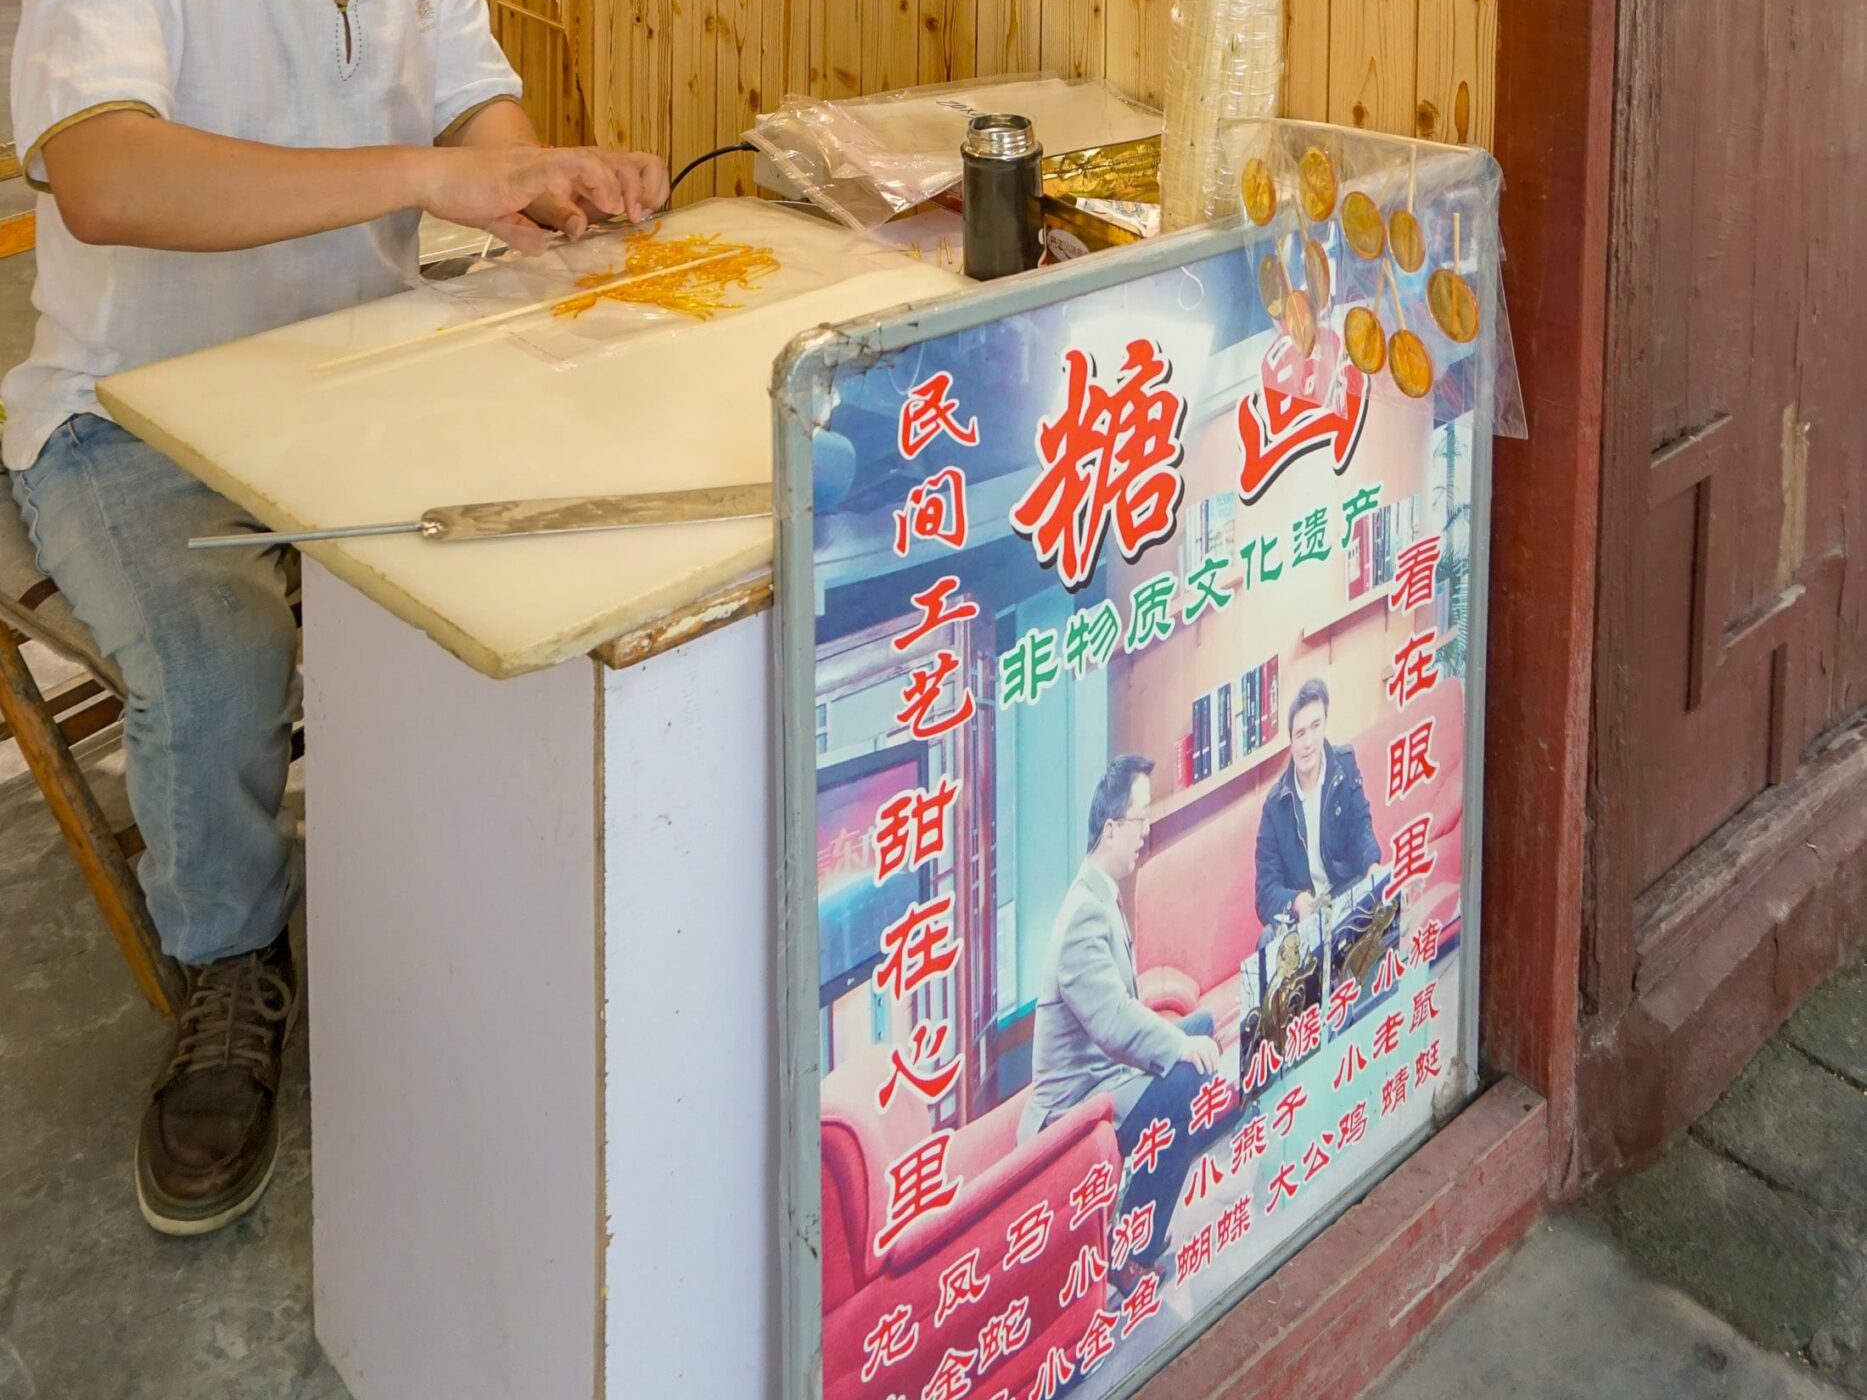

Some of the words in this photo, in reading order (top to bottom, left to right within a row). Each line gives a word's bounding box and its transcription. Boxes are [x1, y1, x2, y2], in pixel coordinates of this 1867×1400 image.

[1012, 336, 1366, 584] 糖画
[1002, 484, 1384, 706] 非物质文化遗产
[1384, 535, 1441, 902] 看在眼里
